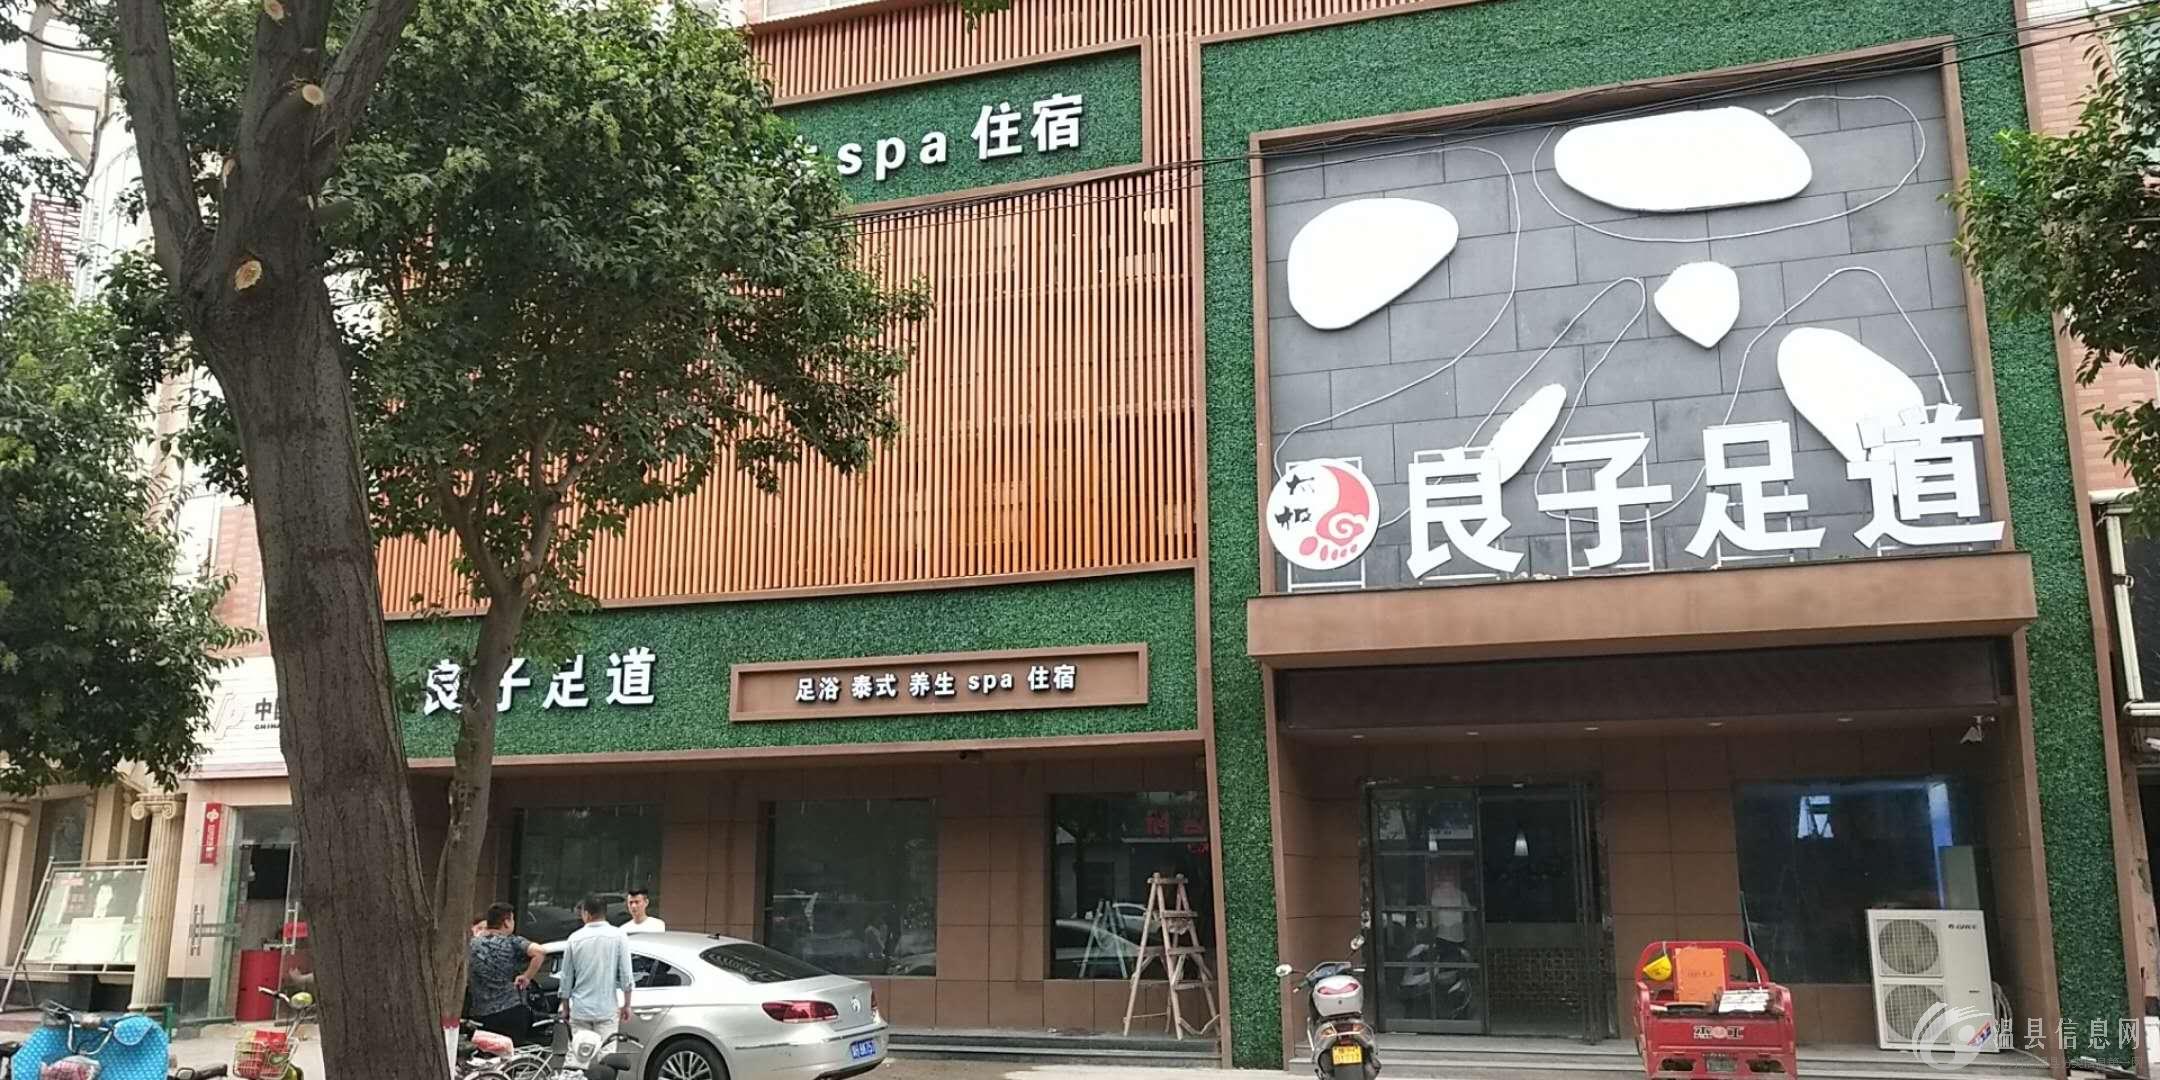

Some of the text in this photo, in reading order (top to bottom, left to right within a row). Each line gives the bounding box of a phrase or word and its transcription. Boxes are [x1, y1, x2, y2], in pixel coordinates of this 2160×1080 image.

[837, 130, 947, 181] spa
[971, 93, 1082, 160] 住宿
[1406, 403, 2005, 579] 良子足道
[796, 664, 1076, 702] 足浴 泰式 养生 spa 住宿
